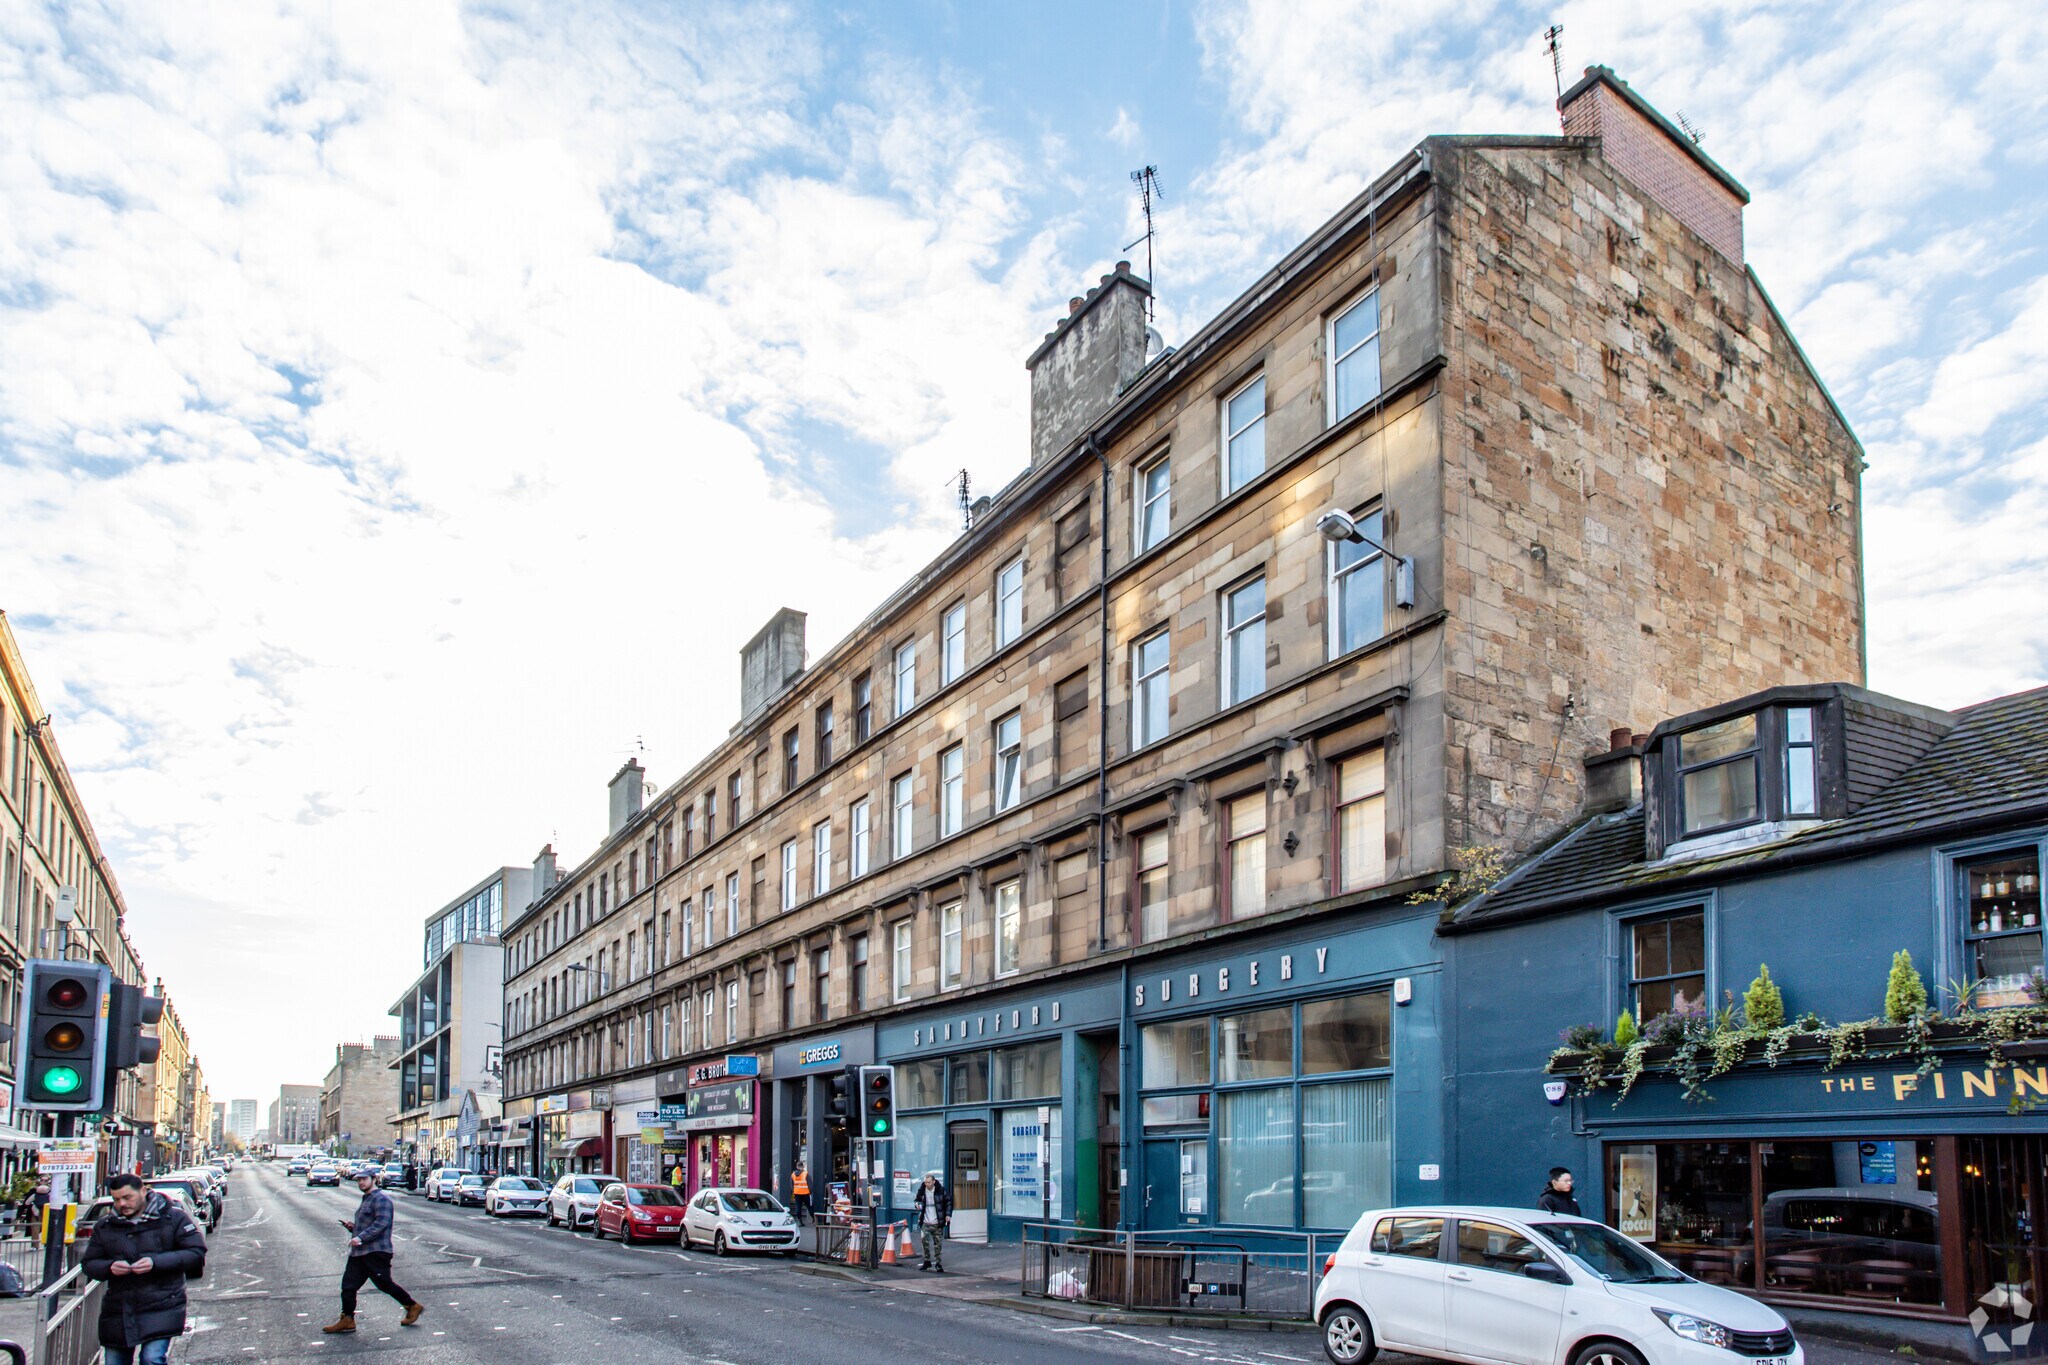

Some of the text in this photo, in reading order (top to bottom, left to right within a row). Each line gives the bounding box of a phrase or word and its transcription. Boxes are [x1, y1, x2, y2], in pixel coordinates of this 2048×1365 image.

[914, 947, 1327, 1046] SANDYFORD SURGERY
[806, 1044, 839, 1063] GREGGS
[1821, 1076, 1876, 1093] THE
[1012, 1126, 1041, 1136] SURGERY
[1210, 1285, 1217, 1293] P
